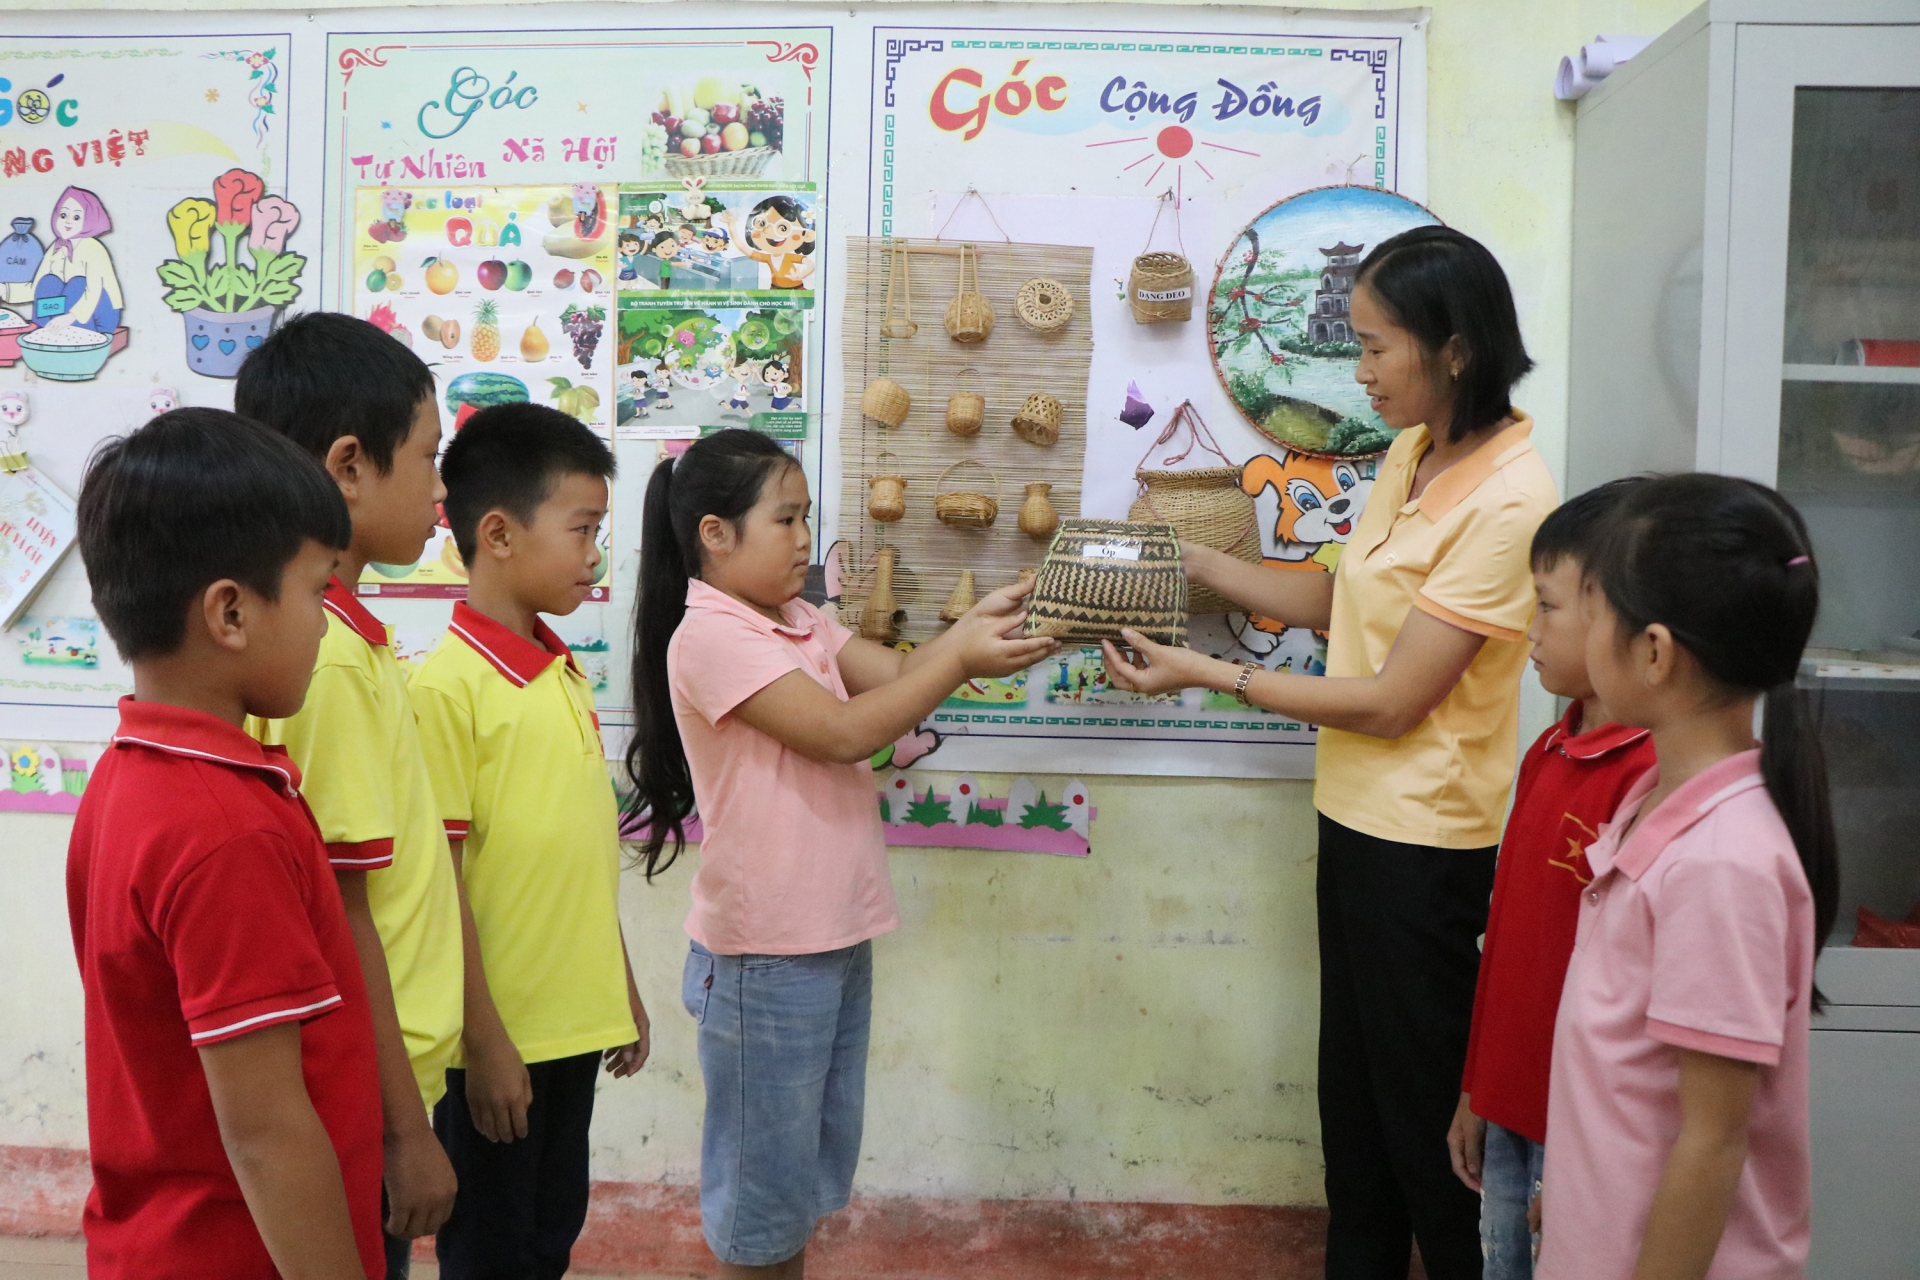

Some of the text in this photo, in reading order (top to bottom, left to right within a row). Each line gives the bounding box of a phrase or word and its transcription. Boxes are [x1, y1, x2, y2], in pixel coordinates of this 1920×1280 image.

[417, 66, 538, 139] Góc
[928, 57, 1322, 142] Góc Cộng Đồng
[0, 128, 149, 178] NG VIỆT
[351, 136, 617, 186] Tự Nhiên Xã Hội
[444, 190, 482, 213] loại
[446, 211, 521, 247] QUẢ
[26, 516, 57, 548] LUYỆN
[19, 569, 31, 583] 3
